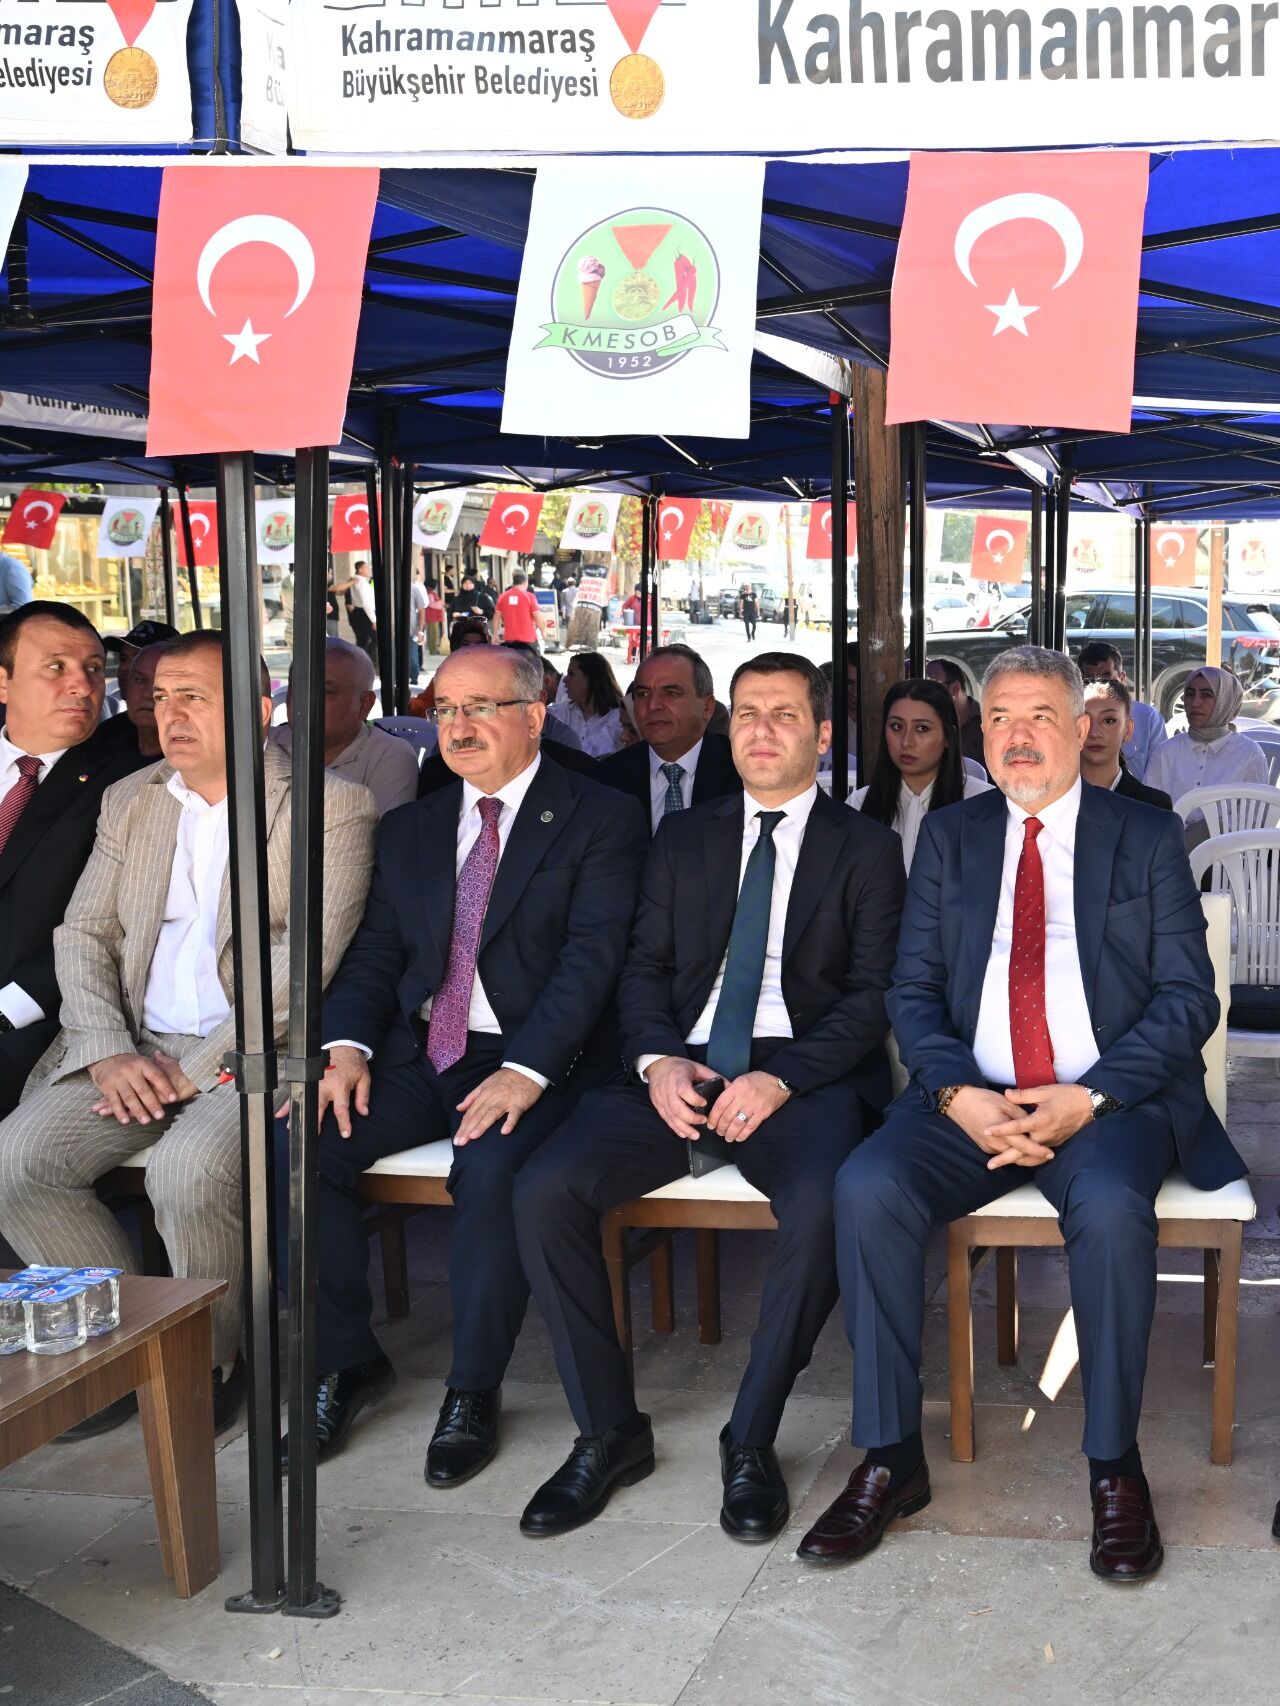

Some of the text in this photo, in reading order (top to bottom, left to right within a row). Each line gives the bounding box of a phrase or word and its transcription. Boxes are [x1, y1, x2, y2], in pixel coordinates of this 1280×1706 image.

[0, 24, 95, 56] maraş
[341, 20, 596, 62] Kahramanmaraş
[0, 57, 93, 94] elediyesi
[342, 64, 599, 103] Büyükşehir Belediyesi
[561, 324, 677, 349] KMESOB
[607, 355, 652, 368] 1952
